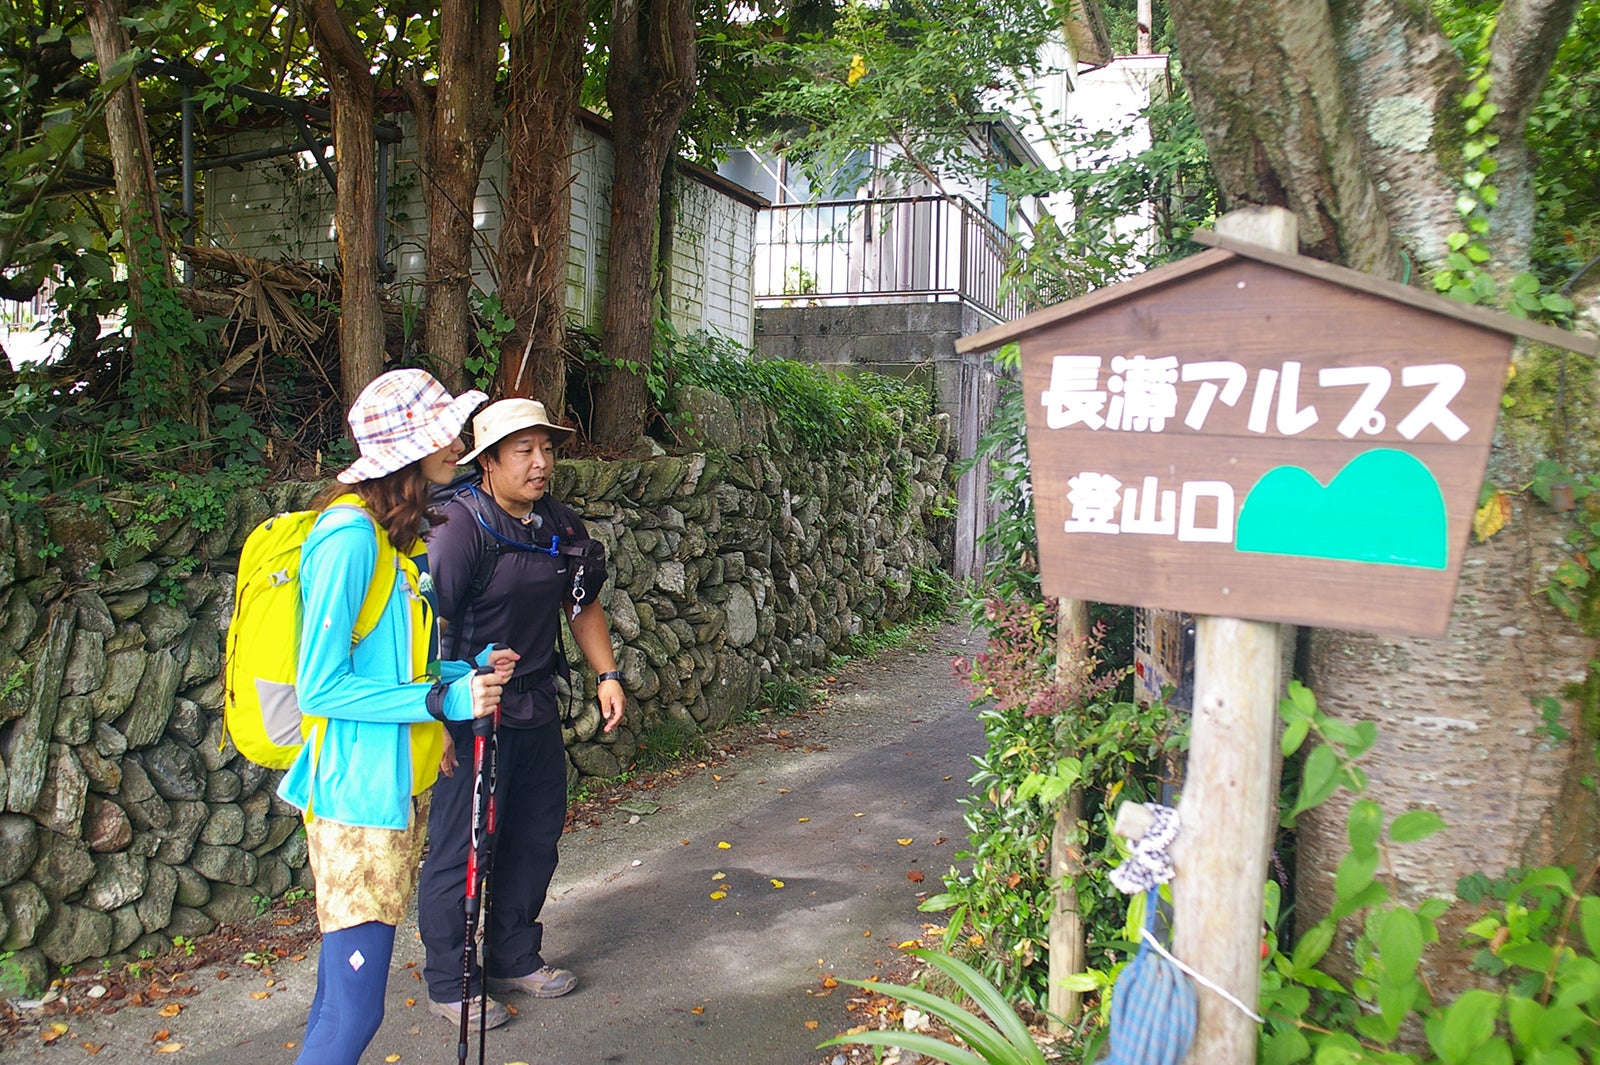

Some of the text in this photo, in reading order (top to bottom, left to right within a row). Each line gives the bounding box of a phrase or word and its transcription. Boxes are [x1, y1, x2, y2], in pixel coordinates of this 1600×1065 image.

[1040, 354, 1471, 442] 長瀞アルプス
[1064, 471, 1236, 544] 登山口
